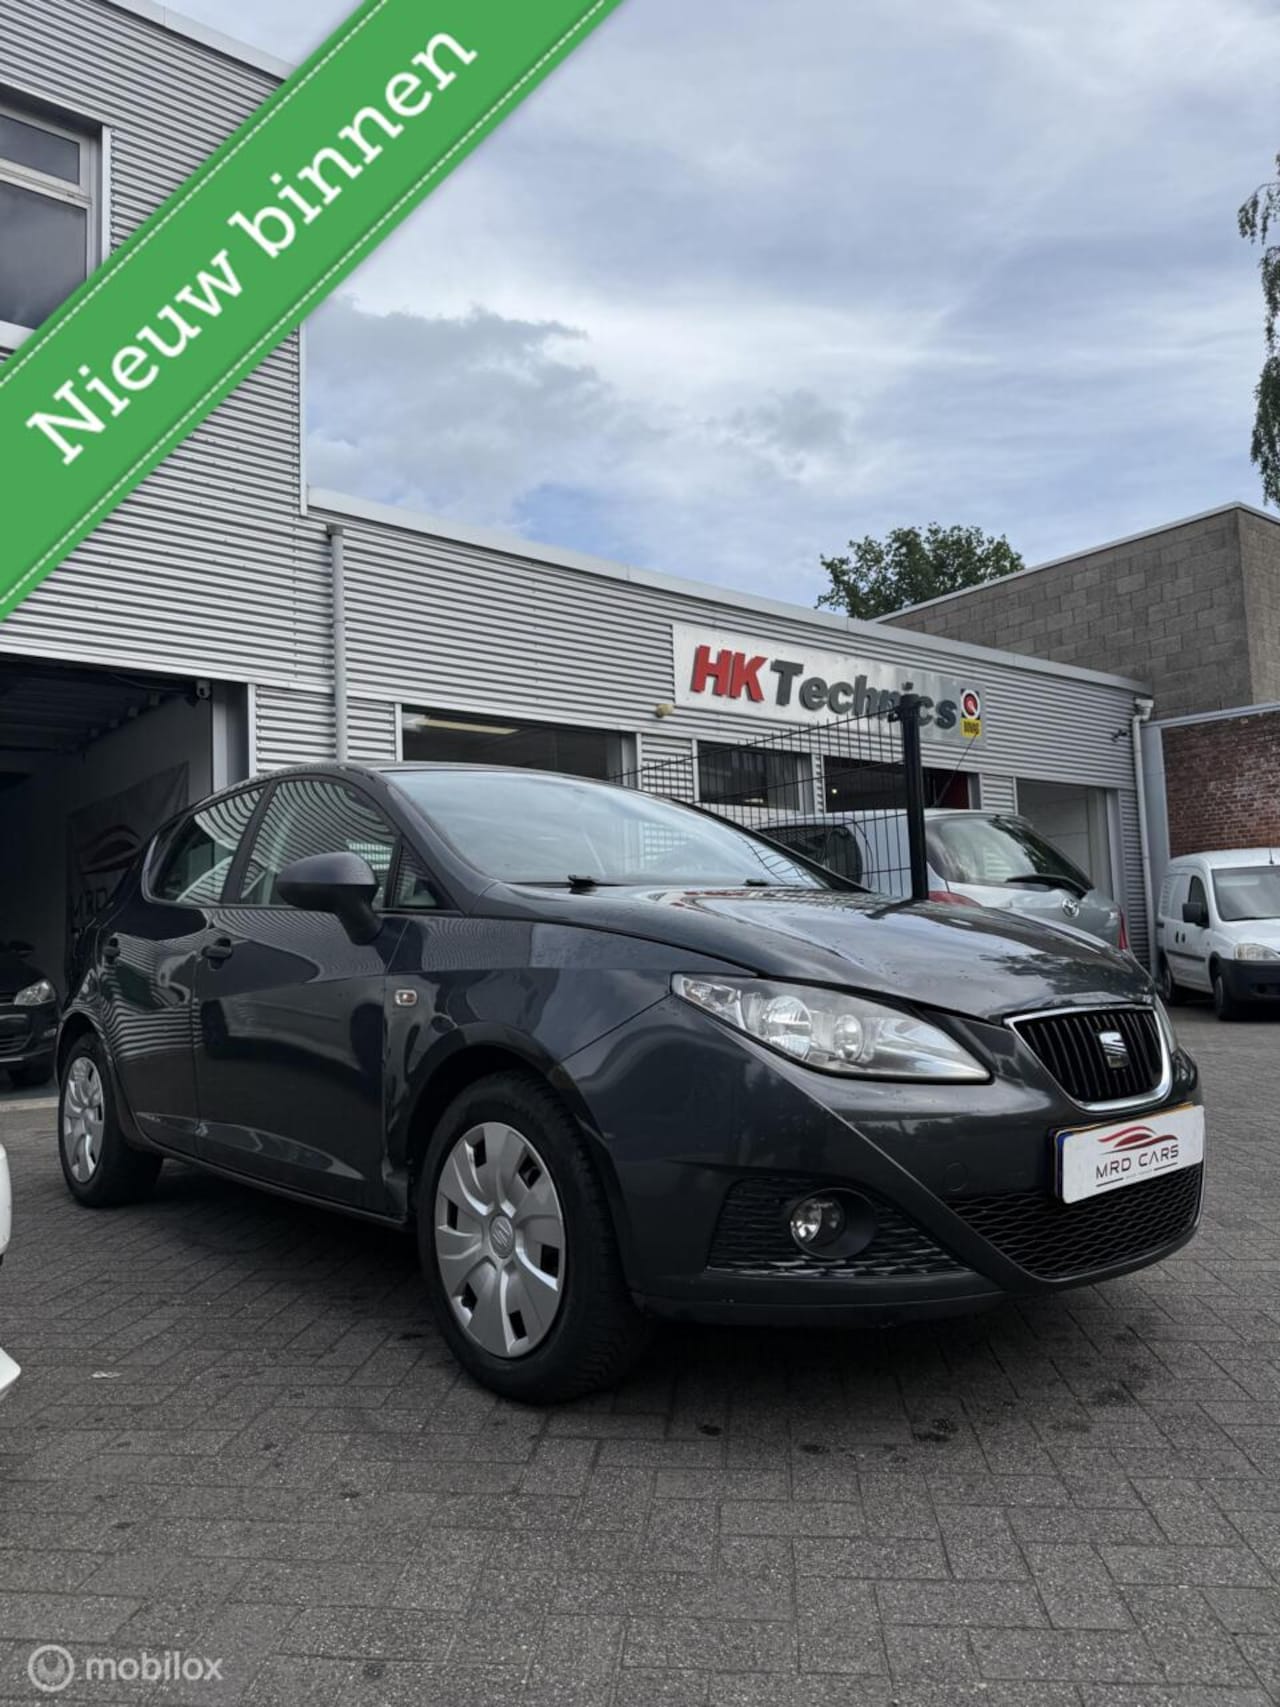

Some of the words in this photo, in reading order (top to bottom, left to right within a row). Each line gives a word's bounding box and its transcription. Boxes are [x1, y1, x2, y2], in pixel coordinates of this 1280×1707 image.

[770, 659, 958, 730] Techncs
[1096, 1157, 1131, 1179] MRD
[1138, 1144, 1179, 1166] CARS
